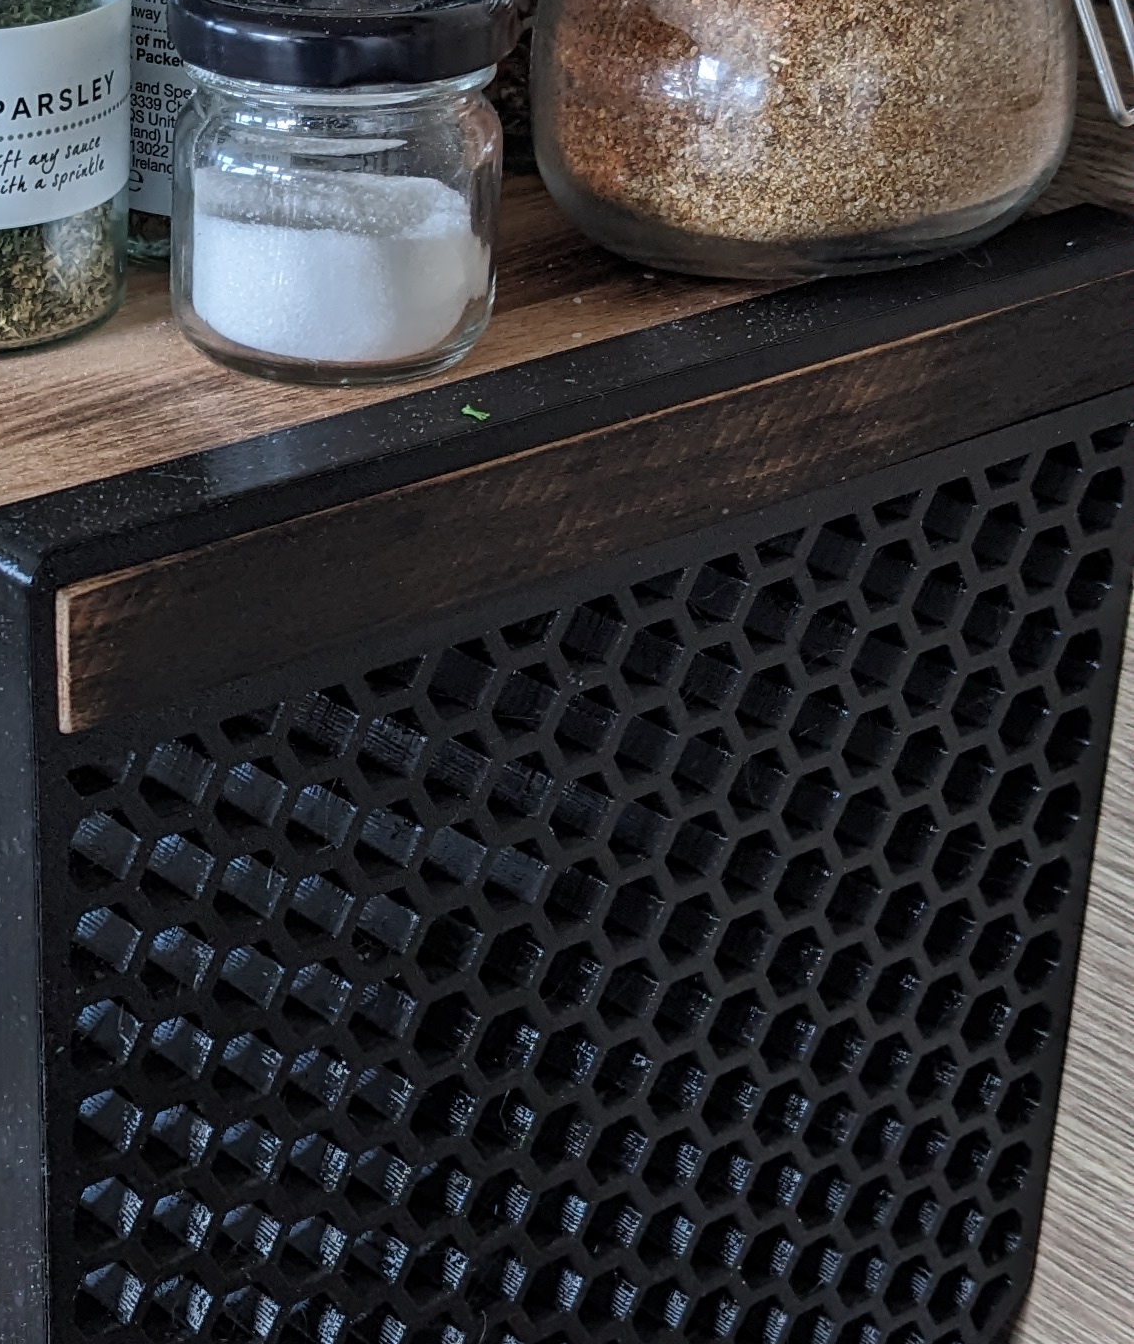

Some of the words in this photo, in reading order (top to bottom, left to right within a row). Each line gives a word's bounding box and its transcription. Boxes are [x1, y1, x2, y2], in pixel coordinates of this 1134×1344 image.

[136, 33, 149, 47] of
[153, 38, 175, 51] mo
[135, 81, 160, 95] and
[164, 83, 192, 101] Spe
[130, 94, 162, 111] 3339
[149, 113, 176, 128] Unit
[131, 124, 161, 145] land)
[28, 148, 60, 175] any
[64, 135, 101, 160] sauce
[130, 140, 169, 159] 13022
[34, 178, 47, 190] a
[51, 154, 105, 192] sprinkle
